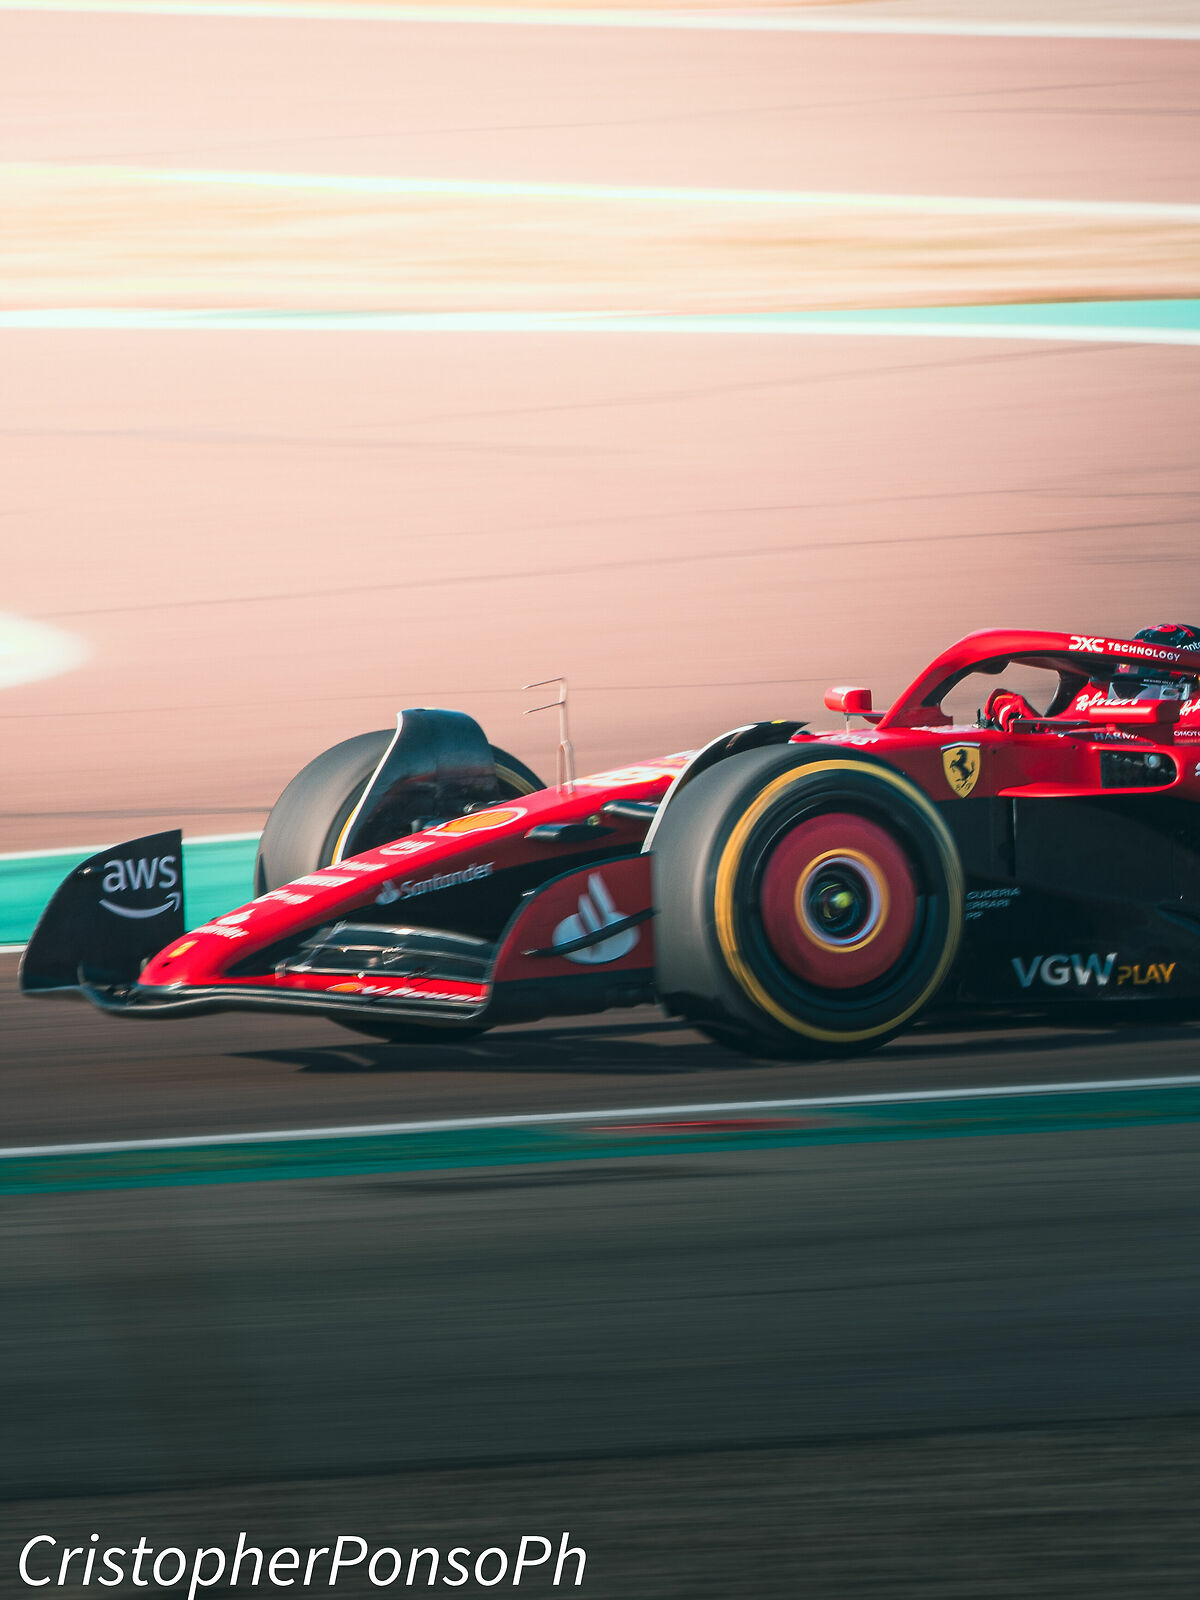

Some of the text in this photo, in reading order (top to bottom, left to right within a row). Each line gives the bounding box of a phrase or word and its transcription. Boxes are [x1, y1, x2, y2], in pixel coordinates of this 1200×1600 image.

[1068, 635, 1181, 662] DXC TECHNOLOGY
[102, 855, 177, 893] aws
[400, 861, 496, 900] Santander
[1010, 952, 1177, 988] VGW PLAY
